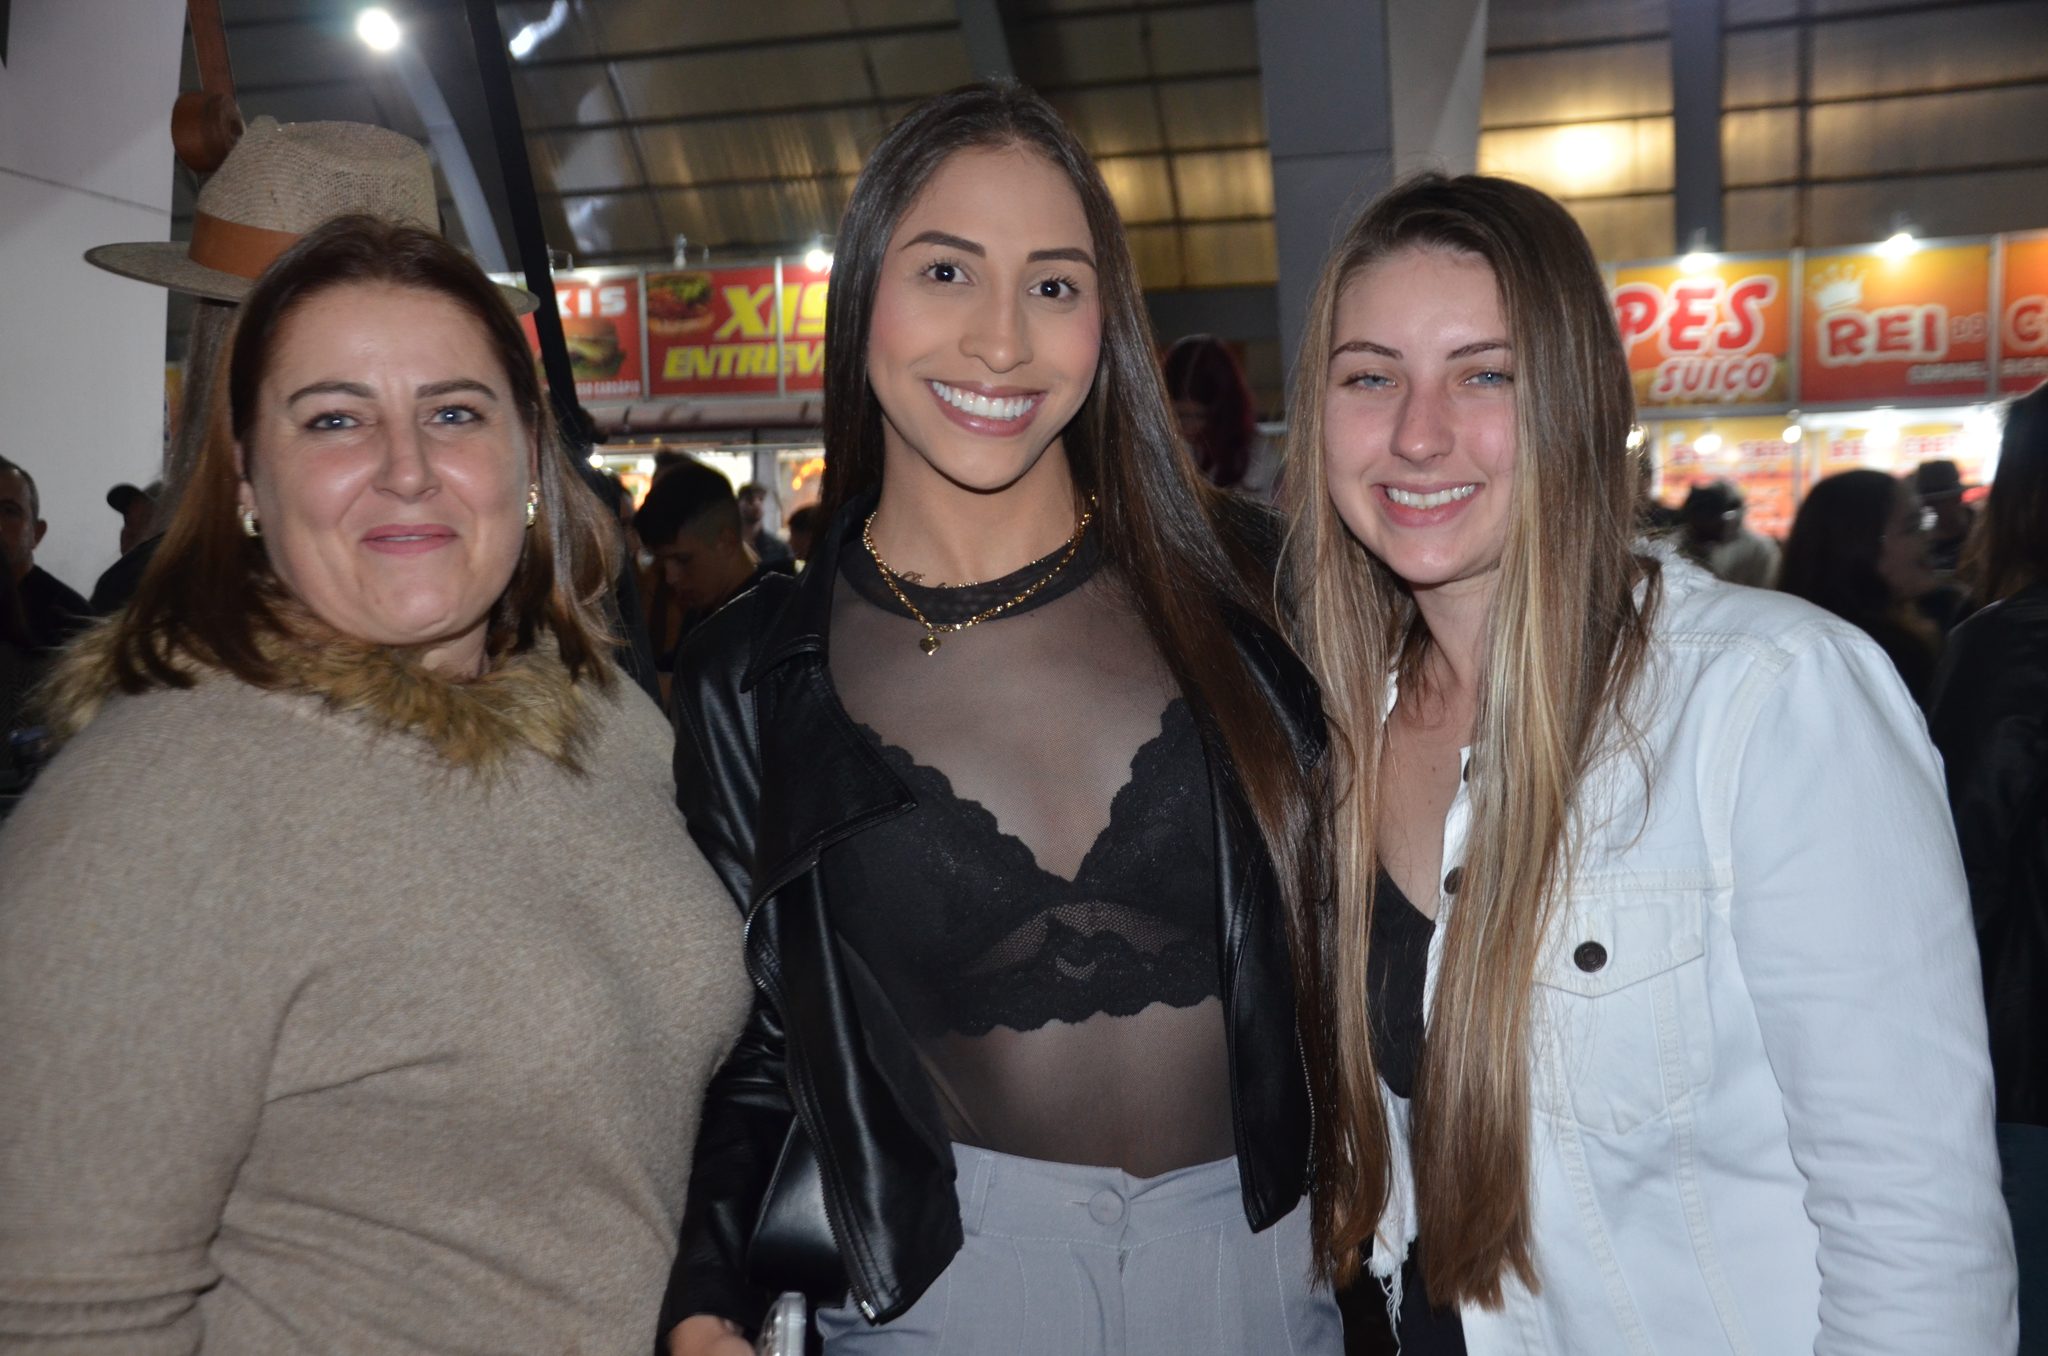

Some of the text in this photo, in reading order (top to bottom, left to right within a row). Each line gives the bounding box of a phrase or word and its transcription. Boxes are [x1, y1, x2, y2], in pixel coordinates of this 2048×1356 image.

[715, 281, 829, 338] XIS
[1823, 308, 1944, 362] REI
[662, 340, 824, 380] ENTREV
